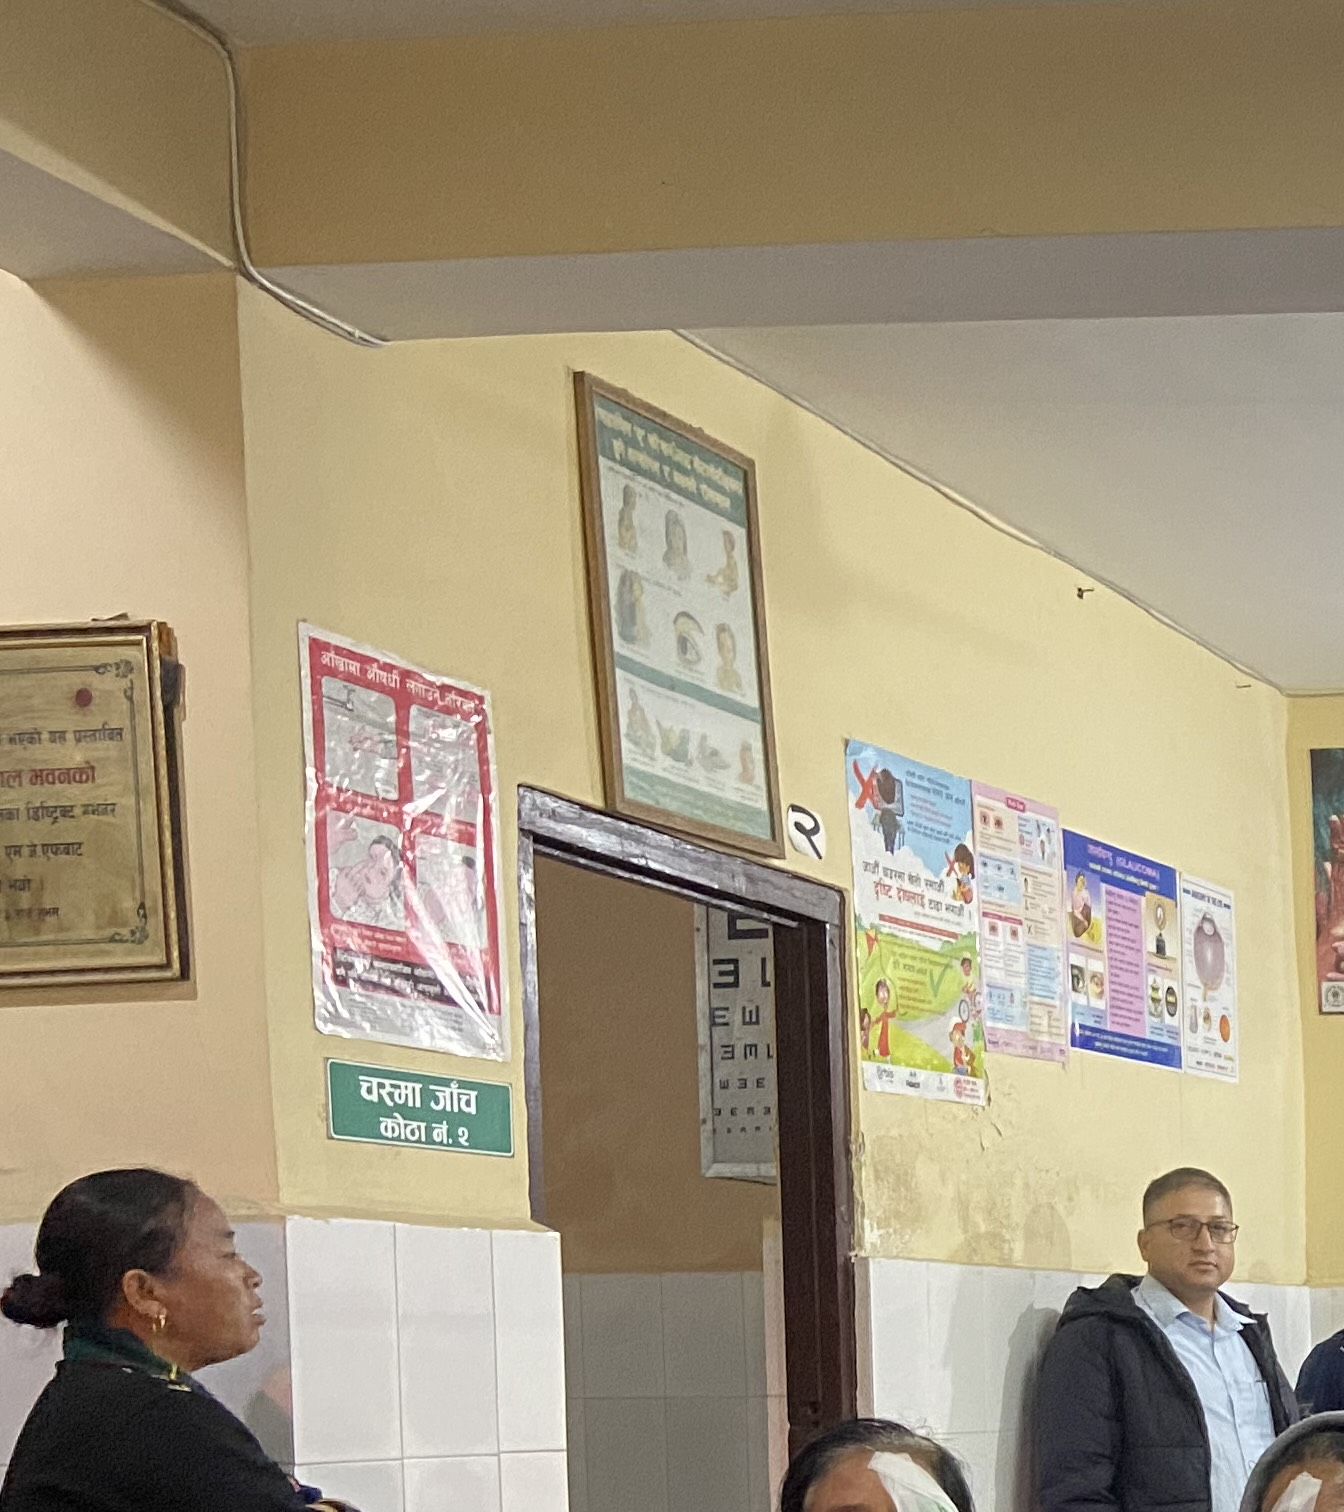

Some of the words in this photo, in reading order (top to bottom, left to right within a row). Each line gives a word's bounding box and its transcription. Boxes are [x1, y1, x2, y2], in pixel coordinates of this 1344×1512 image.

[358, 1075, 423, 1108] चस्मा
[429, 1080, 478, 1115] जाँच
[379, 1112, 426, 1142] कोठा
[458, 1126, 469, 1146] २
